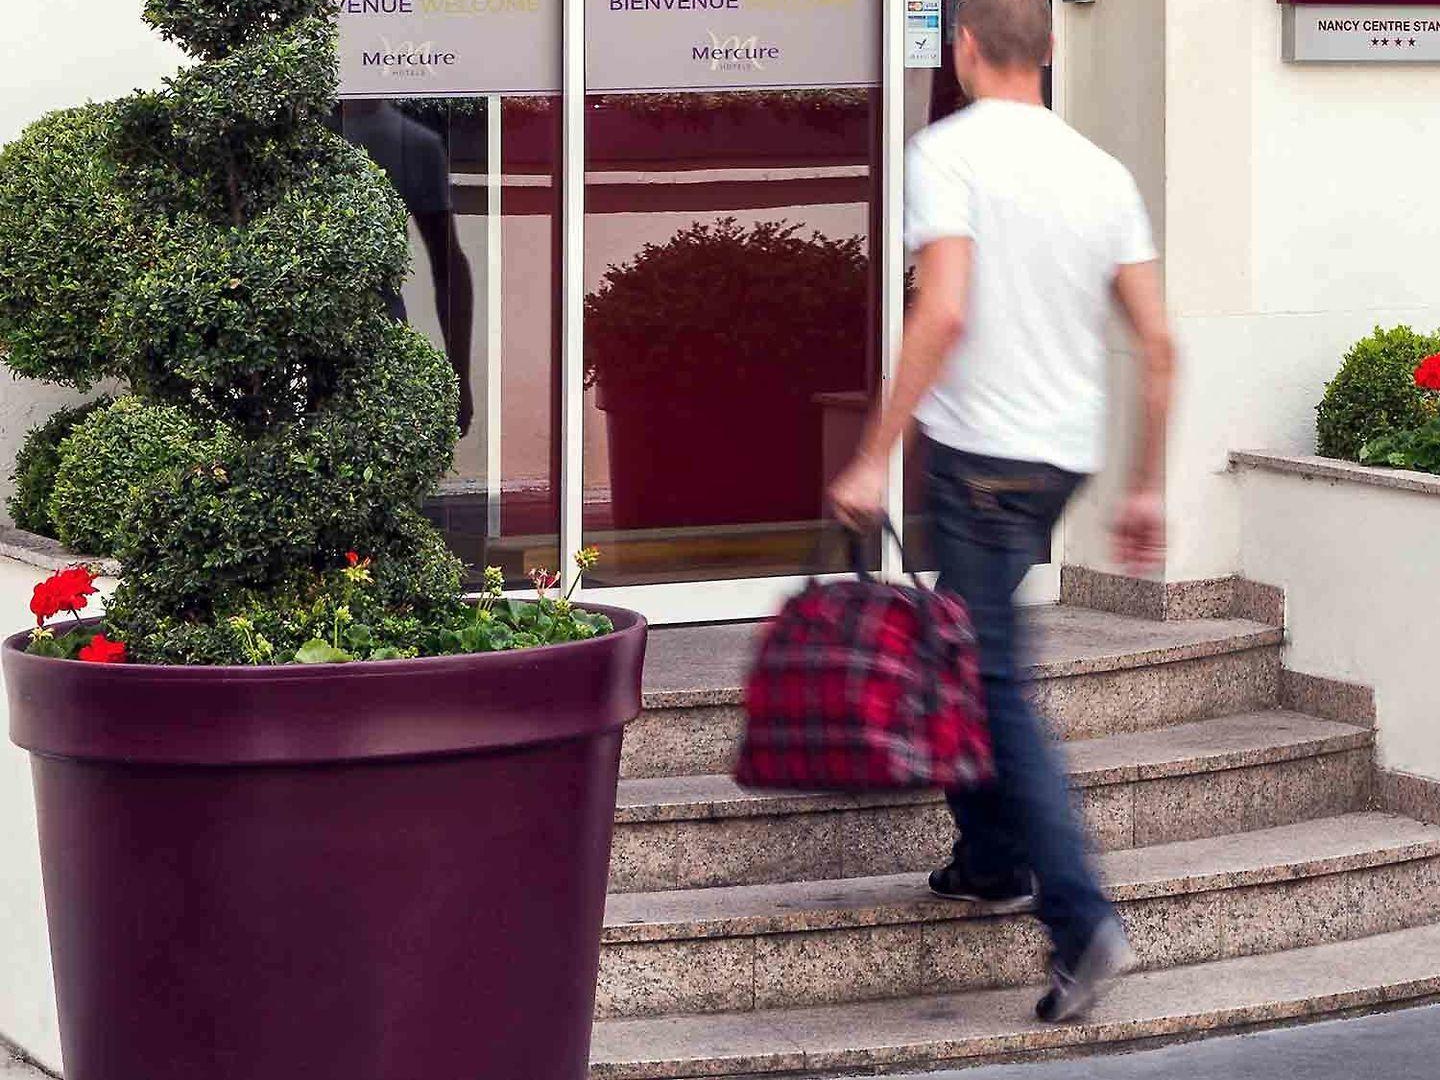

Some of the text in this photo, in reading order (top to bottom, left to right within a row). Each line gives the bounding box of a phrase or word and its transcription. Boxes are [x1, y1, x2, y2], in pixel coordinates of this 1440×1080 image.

[1318, 20, 1359, 31] NANCY
[1363, 21, 1410, 32] CENTRE
[362, 51, 455, 66] Mercure
[692, 46, 779, 60] Mercure
